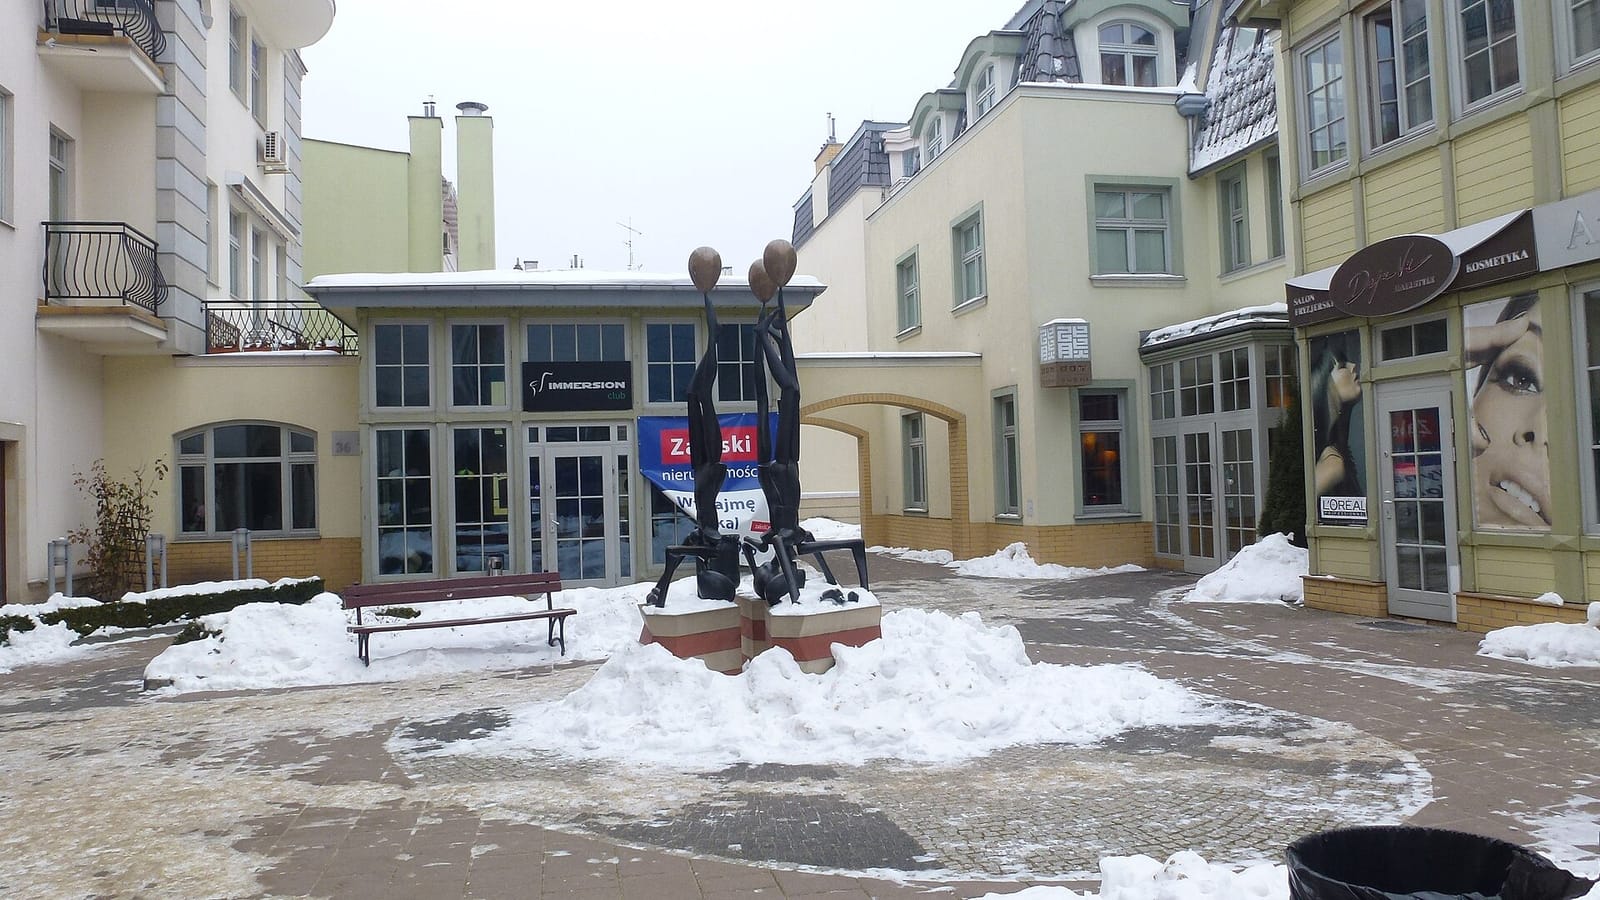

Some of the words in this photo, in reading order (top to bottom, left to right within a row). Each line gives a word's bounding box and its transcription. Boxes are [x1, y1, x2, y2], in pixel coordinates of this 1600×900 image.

[1465, 249, 1529, 273] KOSMETYKA
[1293, 295, 1315, 306] SALON
[1294, 300, 1334, 317] FRYZJERSKI
[548, 381, 626, 390] IMMERSION
[607, 391, 626, 400] club
[336, 441, 351, 454] 36
[670, 434, 752, 456] Zaski
[662, 464, 758, 481] nierumośc
[676, 496, 756, 513] Wajmę
